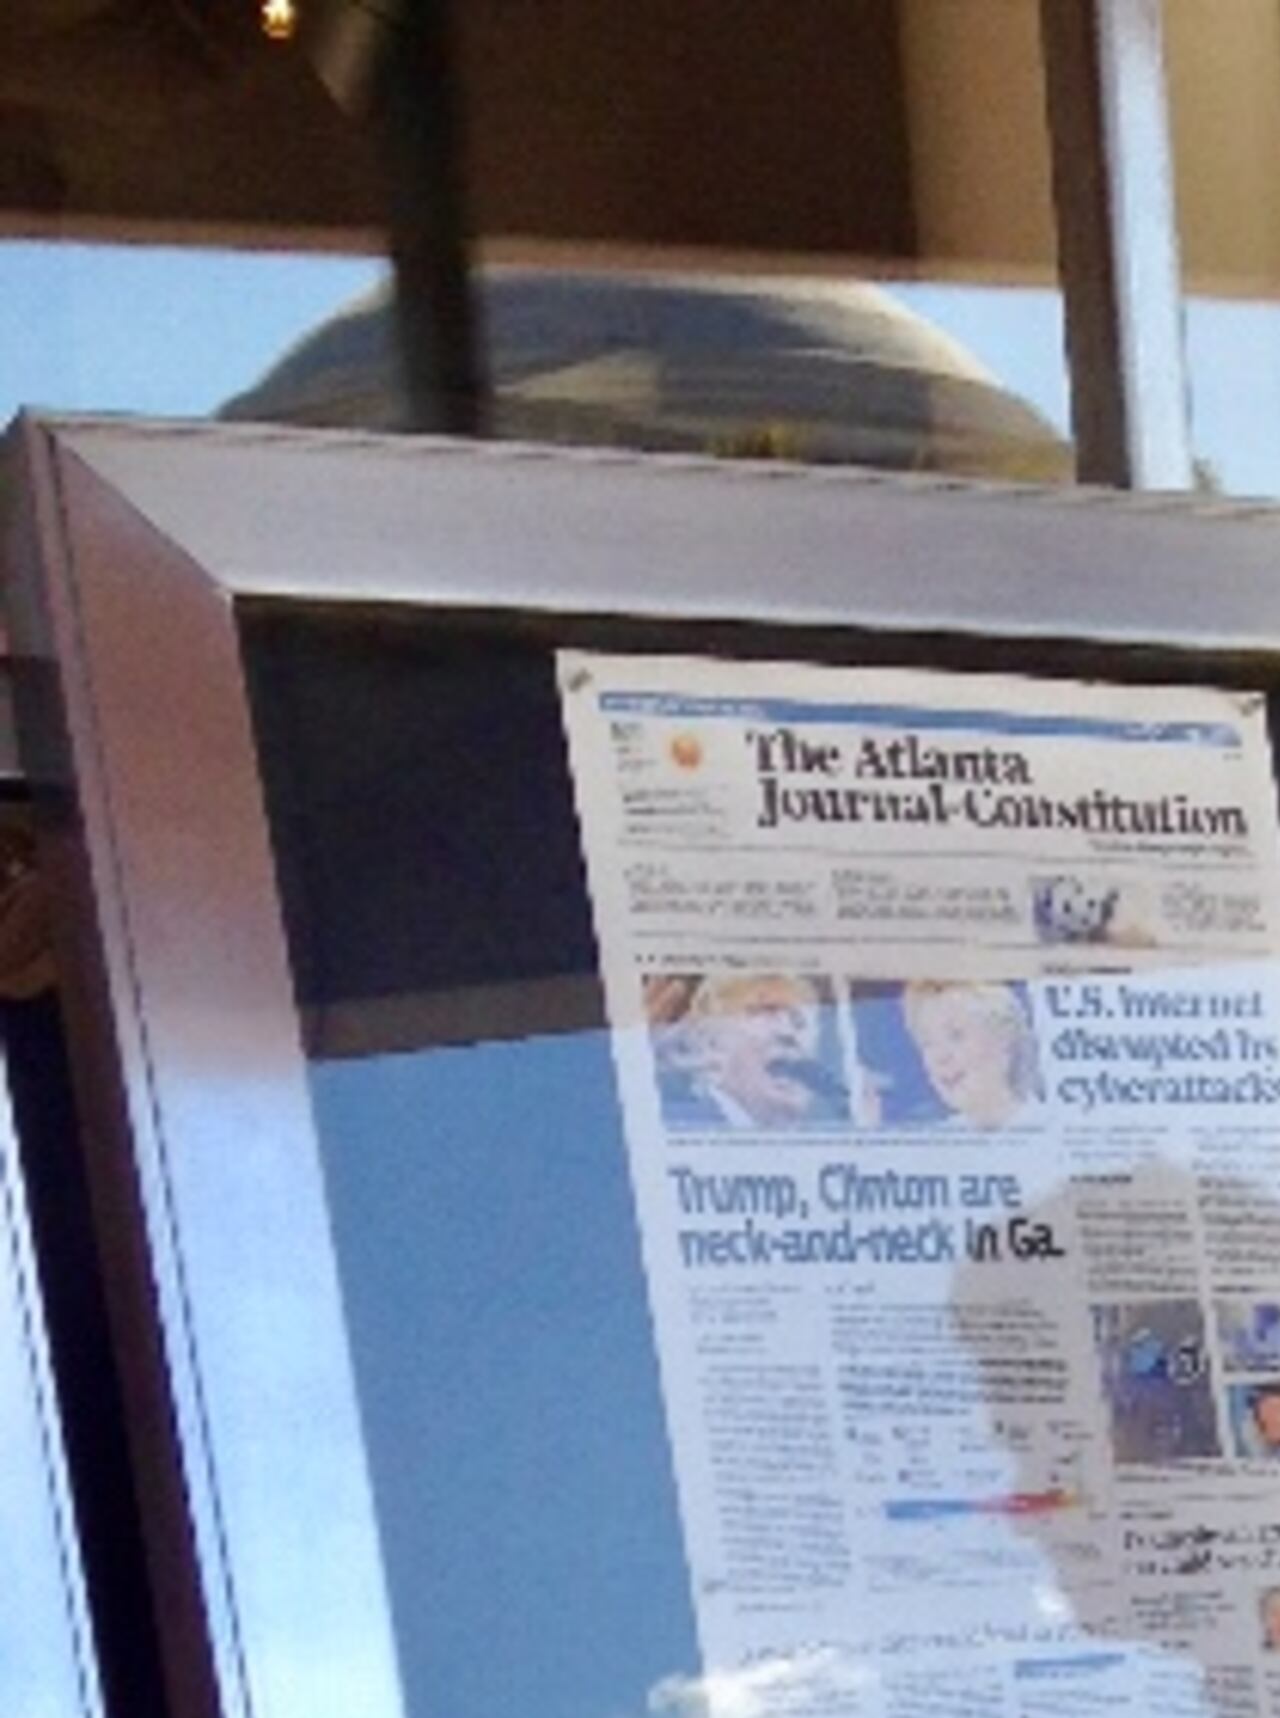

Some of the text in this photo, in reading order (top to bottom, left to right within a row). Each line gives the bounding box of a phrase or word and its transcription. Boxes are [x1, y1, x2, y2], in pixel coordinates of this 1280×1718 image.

[744, 729, 1034, 785] The Atlanta
[756, 777, 1250, 836] Journal-Constitution
[1043, 984, 1115, 1019] U.S.
[666, 1162, 1023, 1219] Trump, Clinton are
[677, 1216, 1068, 1268] neck-and-neck in Ga.
